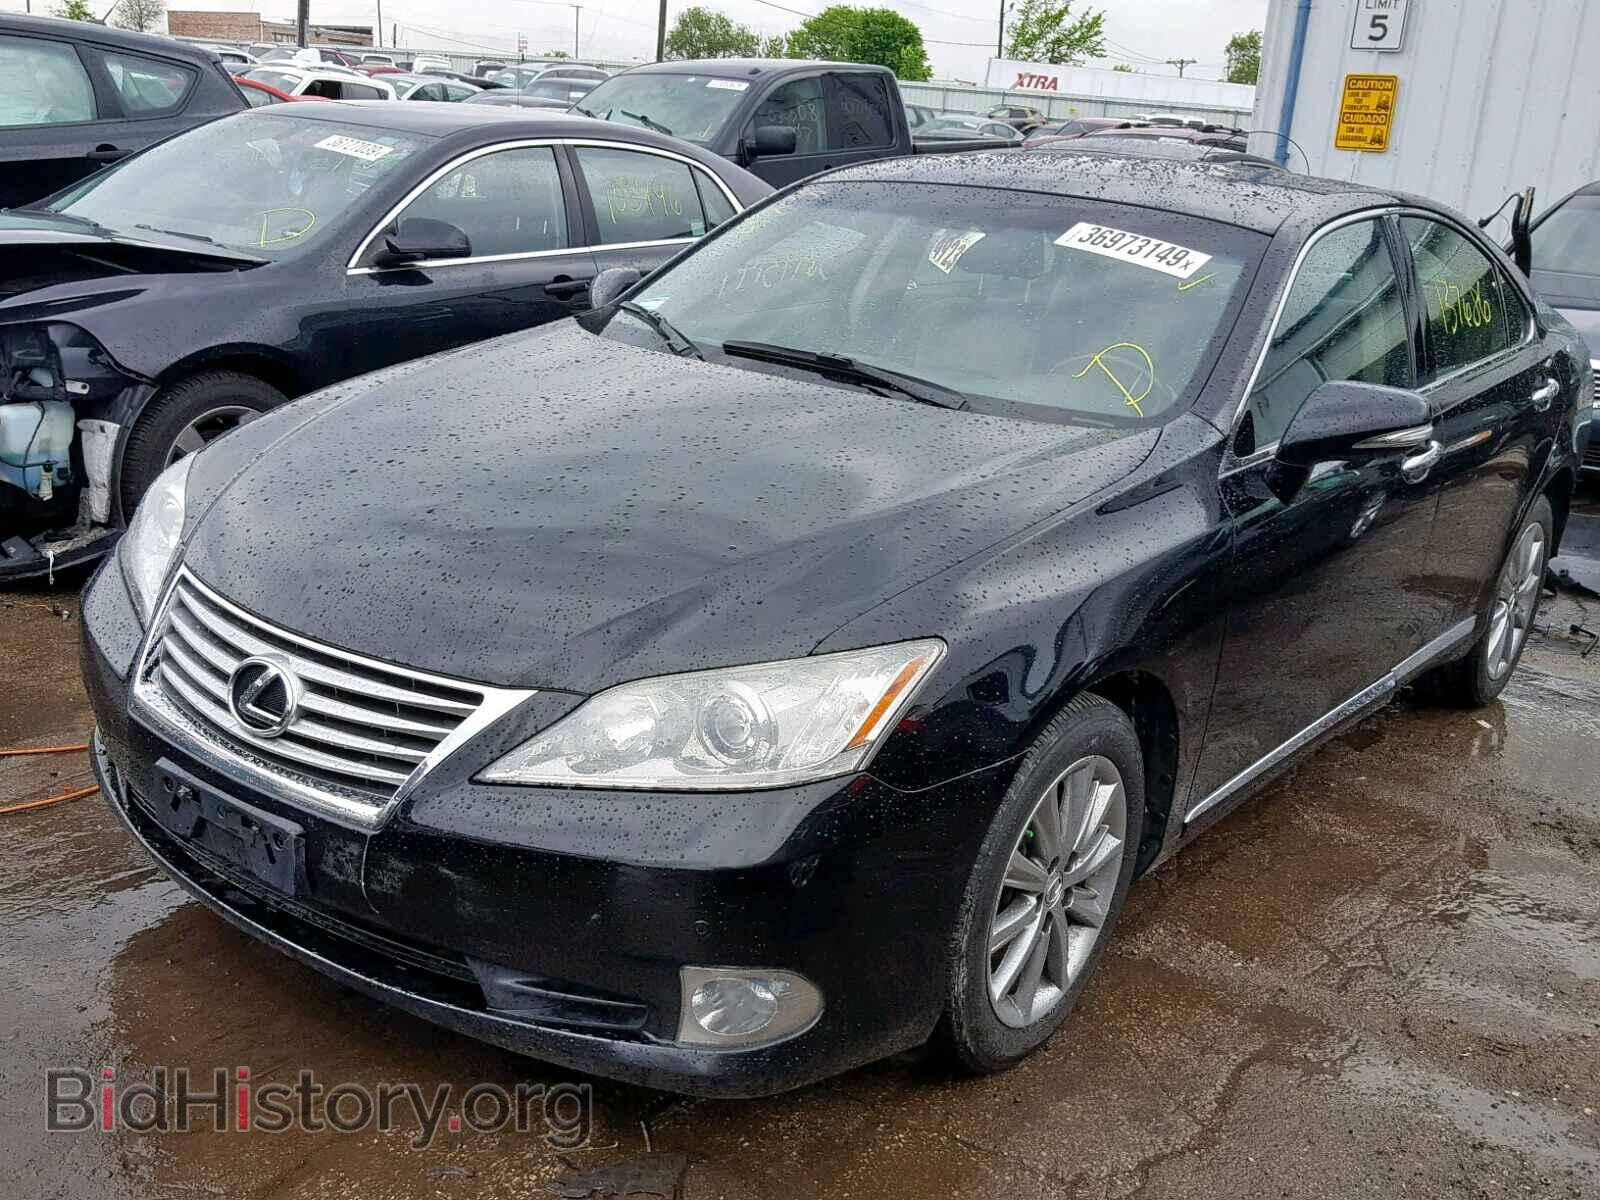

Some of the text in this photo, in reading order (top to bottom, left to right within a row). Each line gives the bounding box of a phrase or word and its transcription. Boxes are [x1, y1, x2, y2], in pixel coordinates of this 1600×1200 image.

[1365, 0, 1400, 9] LIMIT
[1368, 14, 1389, 41] 5
[1012, 72, 1058, 90] XTRA
[1348, 79, 1393, 89] CAUTION
[1343, 114, 1386, 123] CUIDADO
[257, 207, 315, 247] D
[1072, 343, 1153, 417] D
